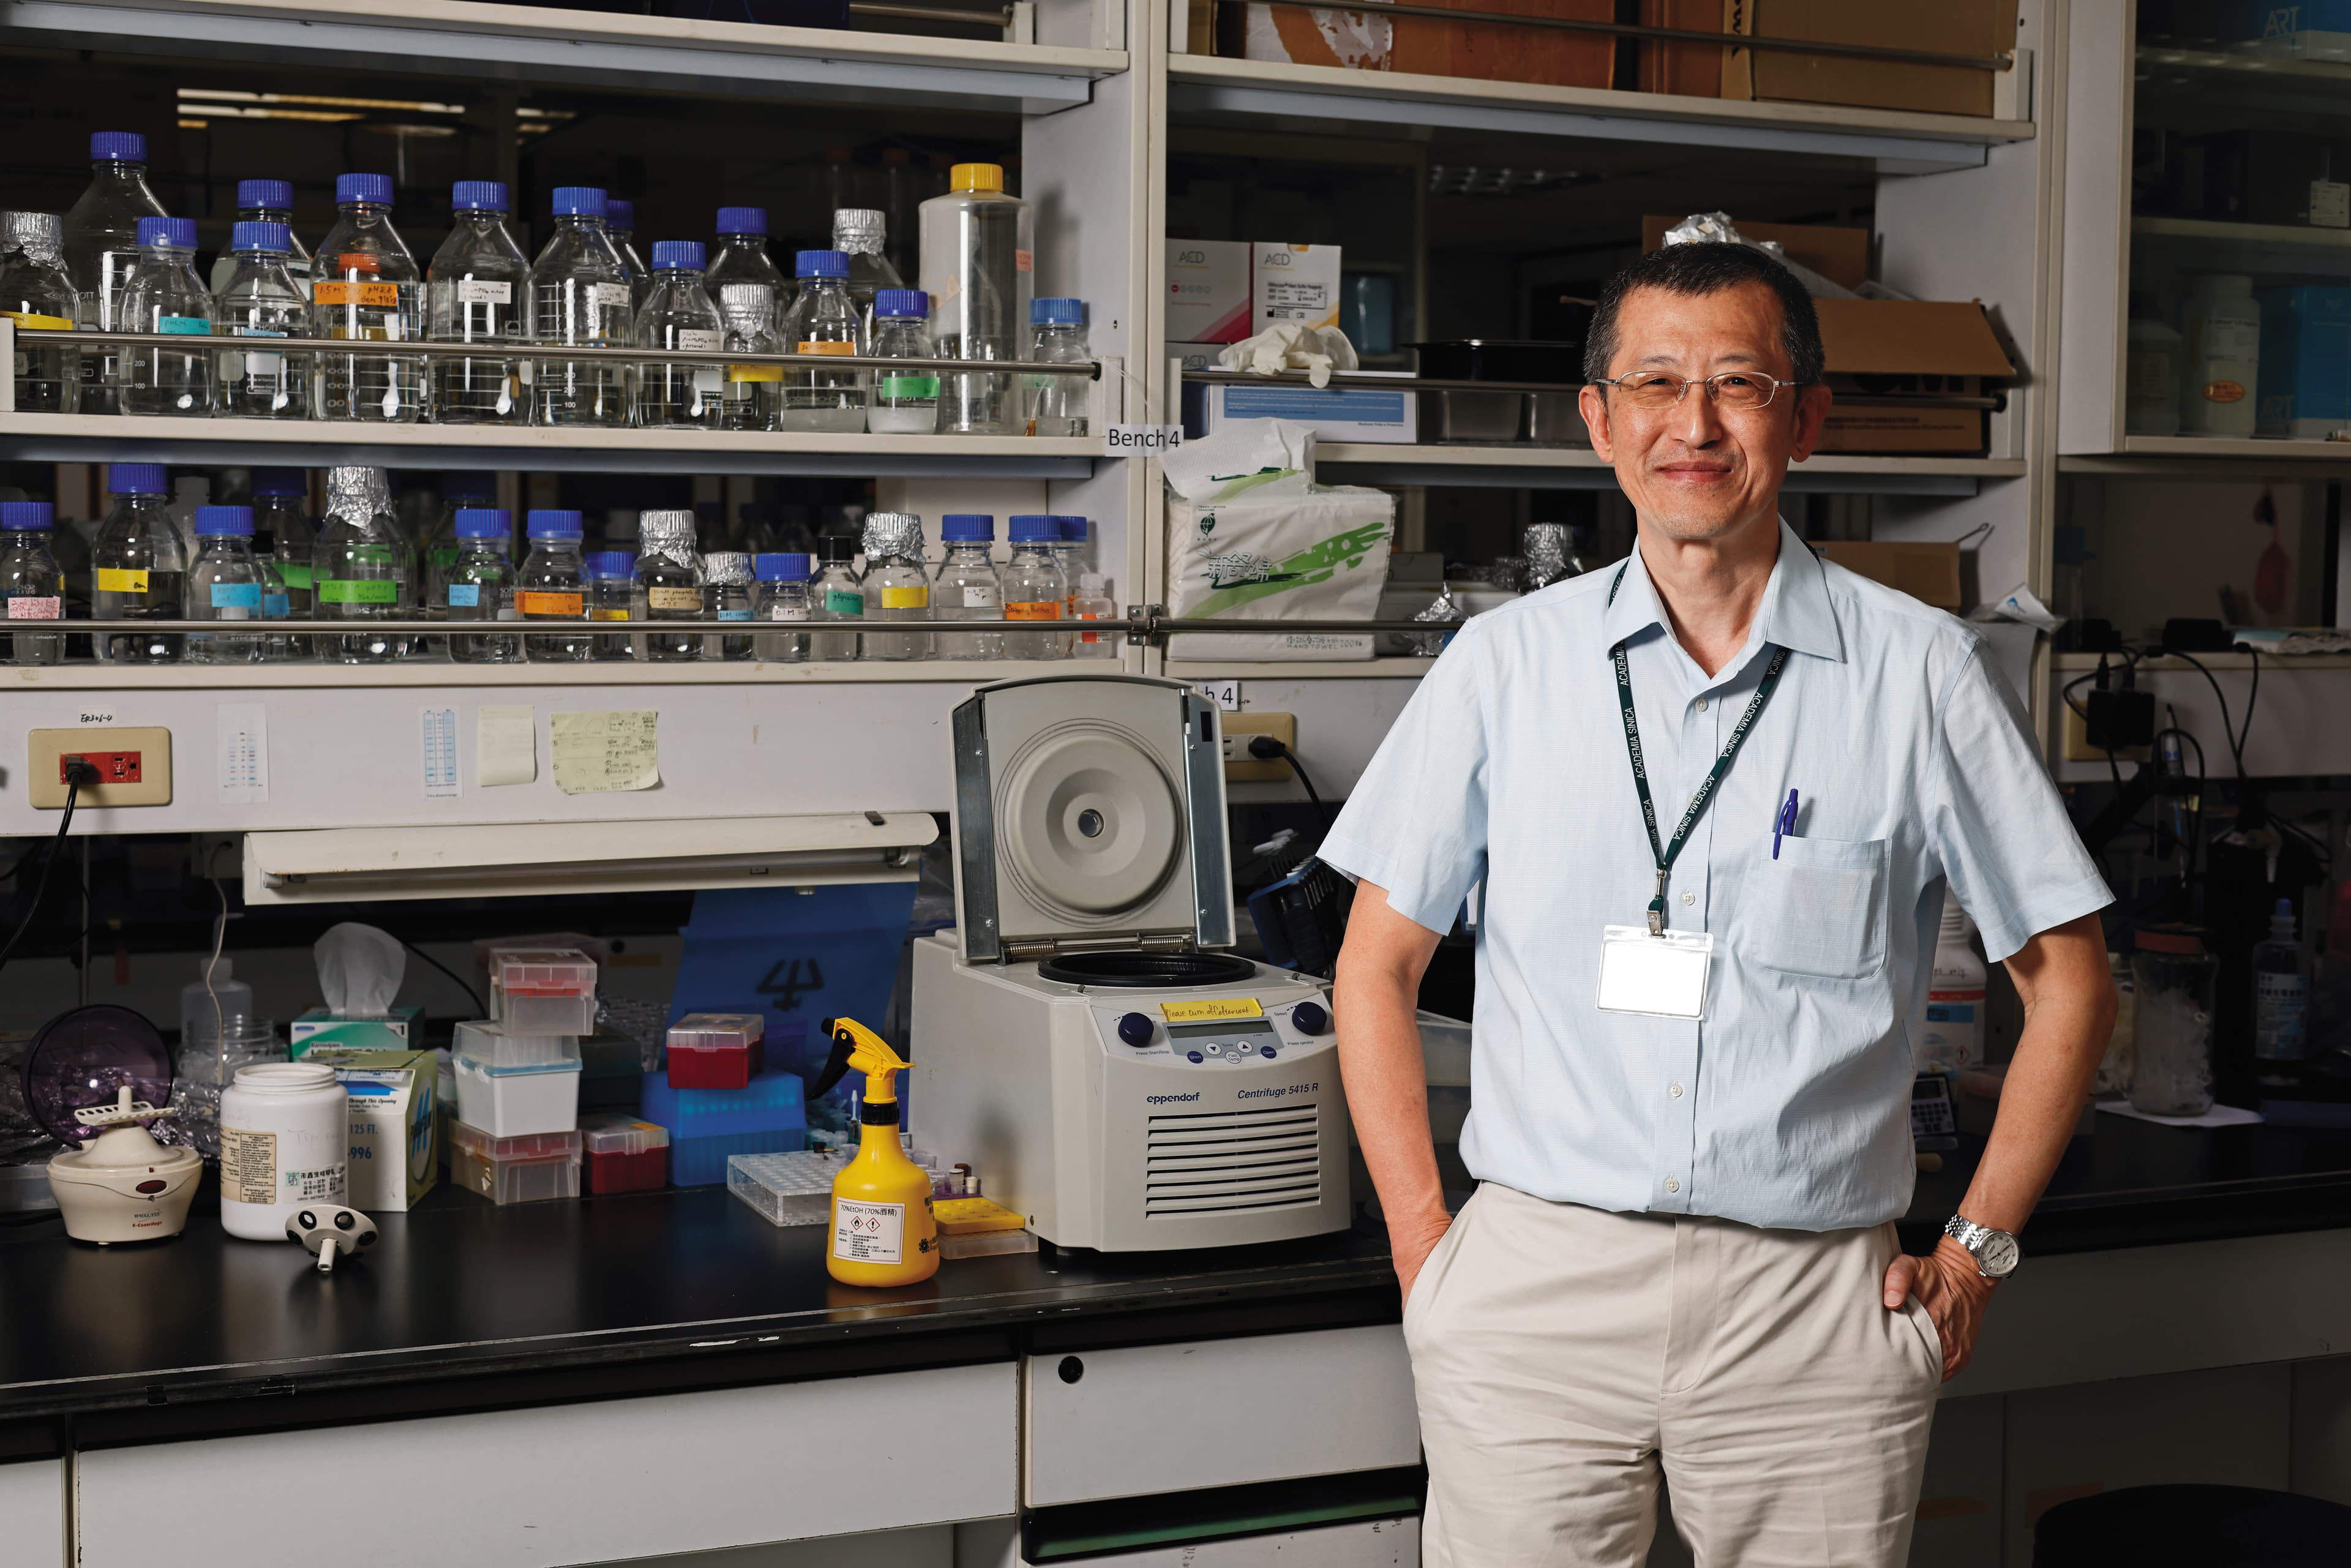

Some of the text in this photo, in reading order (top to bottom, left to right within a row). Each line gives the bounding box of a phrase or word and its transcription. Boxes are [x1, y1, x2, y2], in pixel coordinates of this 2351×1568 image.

[2263, 6, 2300, 38] ART
[1179, 251, 1205, 263] ACD
[1264, 253, 1291, 266] ACD
[1182, 354, 1207, 367] ACD
[1109, 429, 1180, 448] Bench 4
[1616, 646, 1629, 686] ACADEMIA
[1221, 688, 1234, 705] 4
[1721, 691, 1763, 757] ACADEMIA SINICA
[1624, 707, 1646, 779] SINICA ACADEMIA
[1643, 798, 1655, 827] SINICA
[1673, 773, 1715, 841] ACADEMIA SINICA
[1165, 1008, 1186, 1017] Please
[1147, 1092, 1200, 1105] eppendorf
[1237, 1082, 1319, 1099] Centrifuge 5415 R
[350, 1124, 365, 1134] 125
[841, 1204, 897, 1217] 70%EtOH (70%酒精)
